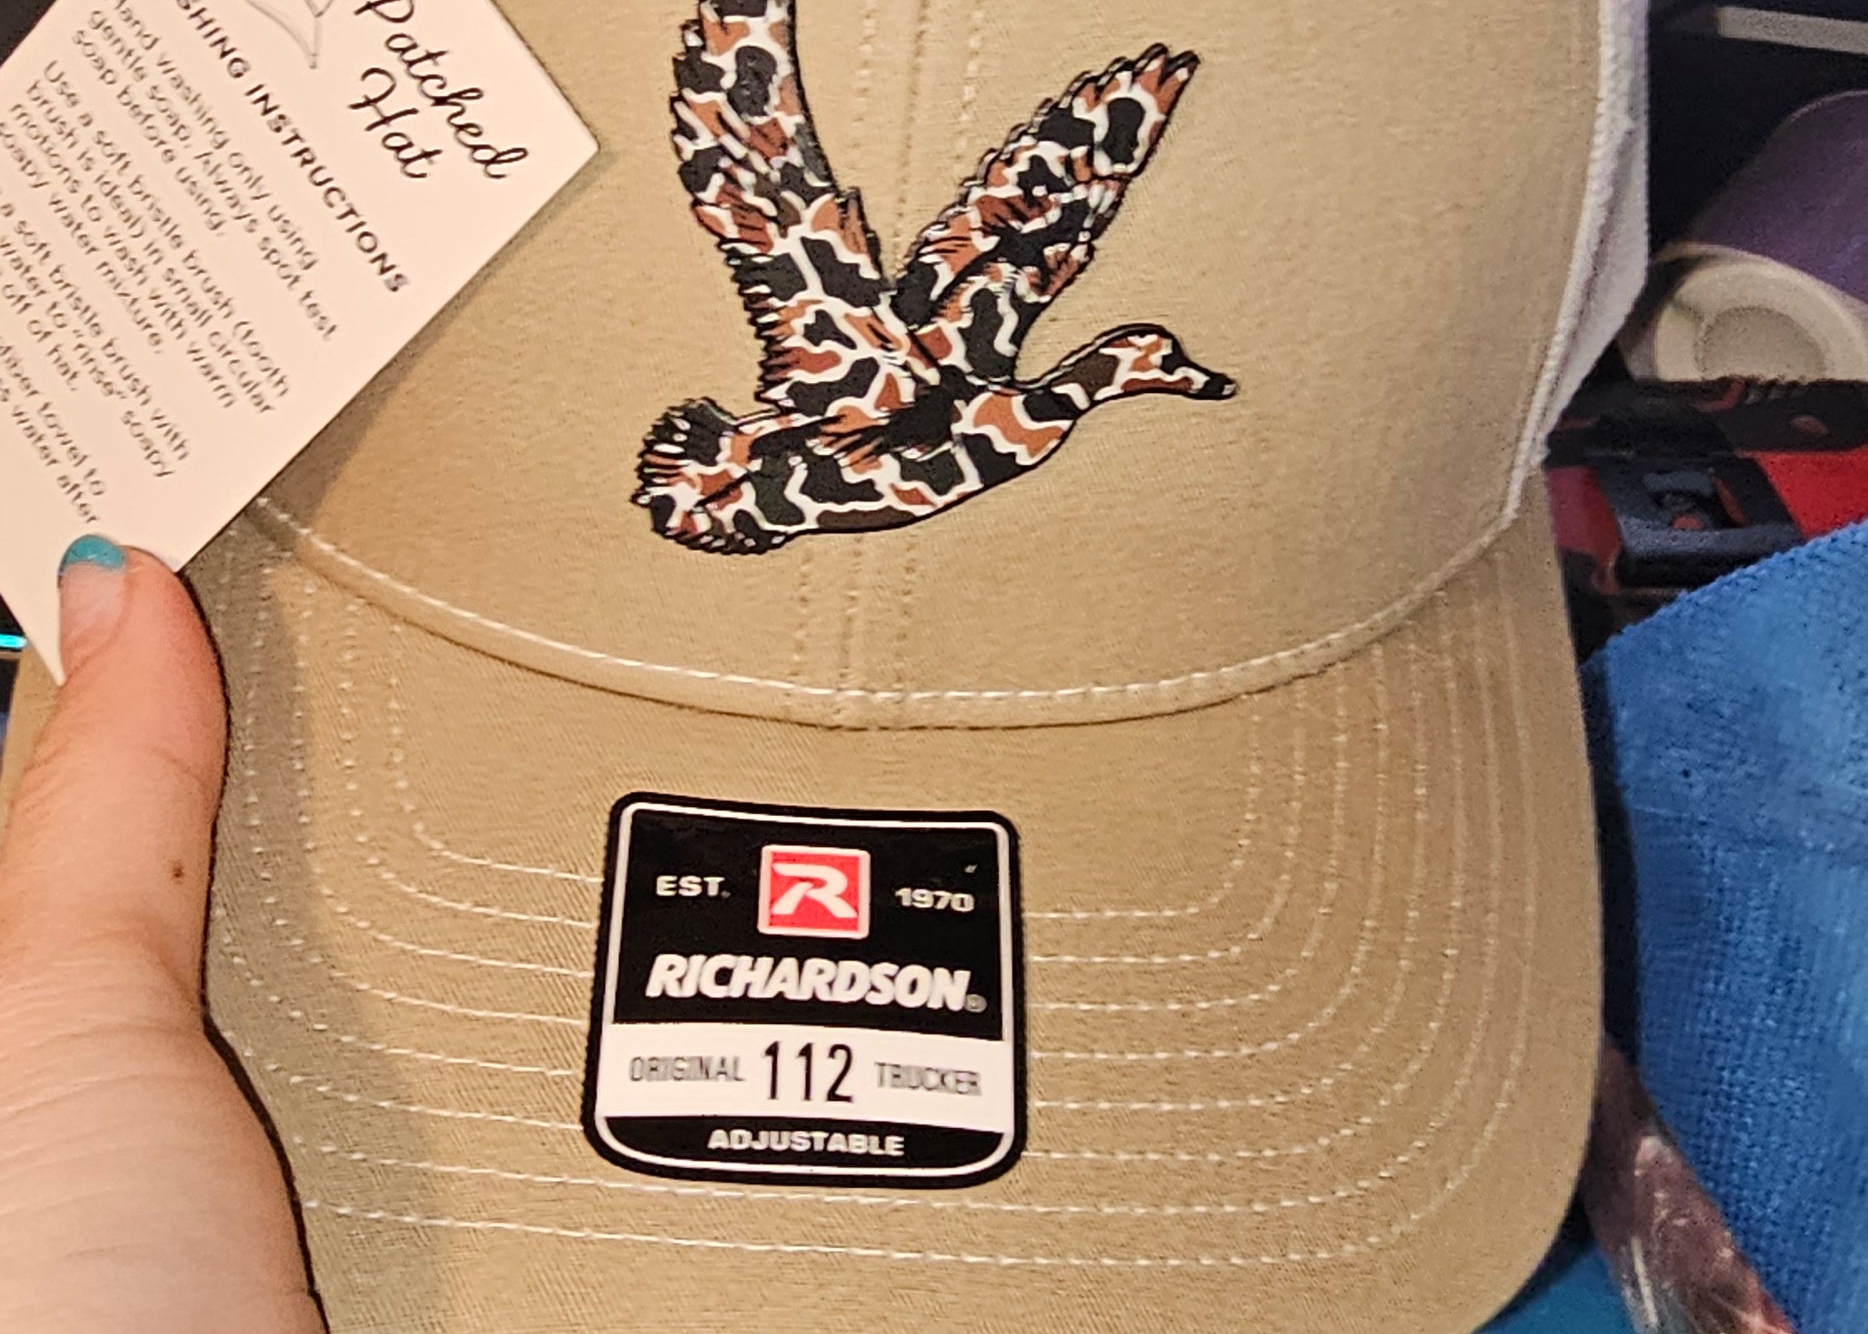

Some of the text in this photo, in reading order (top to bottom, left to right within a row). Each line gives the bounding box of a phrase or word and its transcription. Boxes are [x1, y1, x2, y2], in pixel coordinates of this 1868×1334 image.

[72, 30, 118, 85] soap
[116, 84, 177, 164] before
[156, 53, 230, 150] washing
[228, 152, 272, 201] only
[267, 205, 319, 270] using
[347, 67, 444, 179] Hat
[44, 60, 80, 108] Use
[78, 113, 93, 127] a
[92, 130, 132, 176] soft
[127, 174, 184, 249] bristle
[182, 249, 234, 319] brush
[48, 193, 100, 255] water
[88, 10, 147, 82] gentle
[193, 151, 259, 233] Always
[258, 236, 302, 291] spot
[299, 290, 339, 343] test
[244, 84, 409, 293] INSTRUCTIONS
[1, 284, 34, 315] off
[28, 319, 54, 343] of
[9, 104, 236, 408] motions to wash with warm
[26, 80, 79, 149] brush
[76, 148, 95, 172] is
[143, 239, 164, 265] in
[162, 268, 213, 328] small
[208, 331, 275, 413] circular
[14, 220, 52, 266] soft
[48, 264, 104, 338] bristle
[101, 337, 151, 406] brush
[150, 408, 189, 460] with
[45, 301, 68, 329] to
[121, 410, 174, 477] soapy
[12, 405, 100, 523] water after
[37, 402, 89, 467] towel
[81, 468, 104, 496] to
[656, 863, 975, 919] EST. R 1970
[629, 1040, 982, 1104] ORIGINAL 112 TRUCKER
[707, 1128, 905, 1157] ADJUSTABLE
